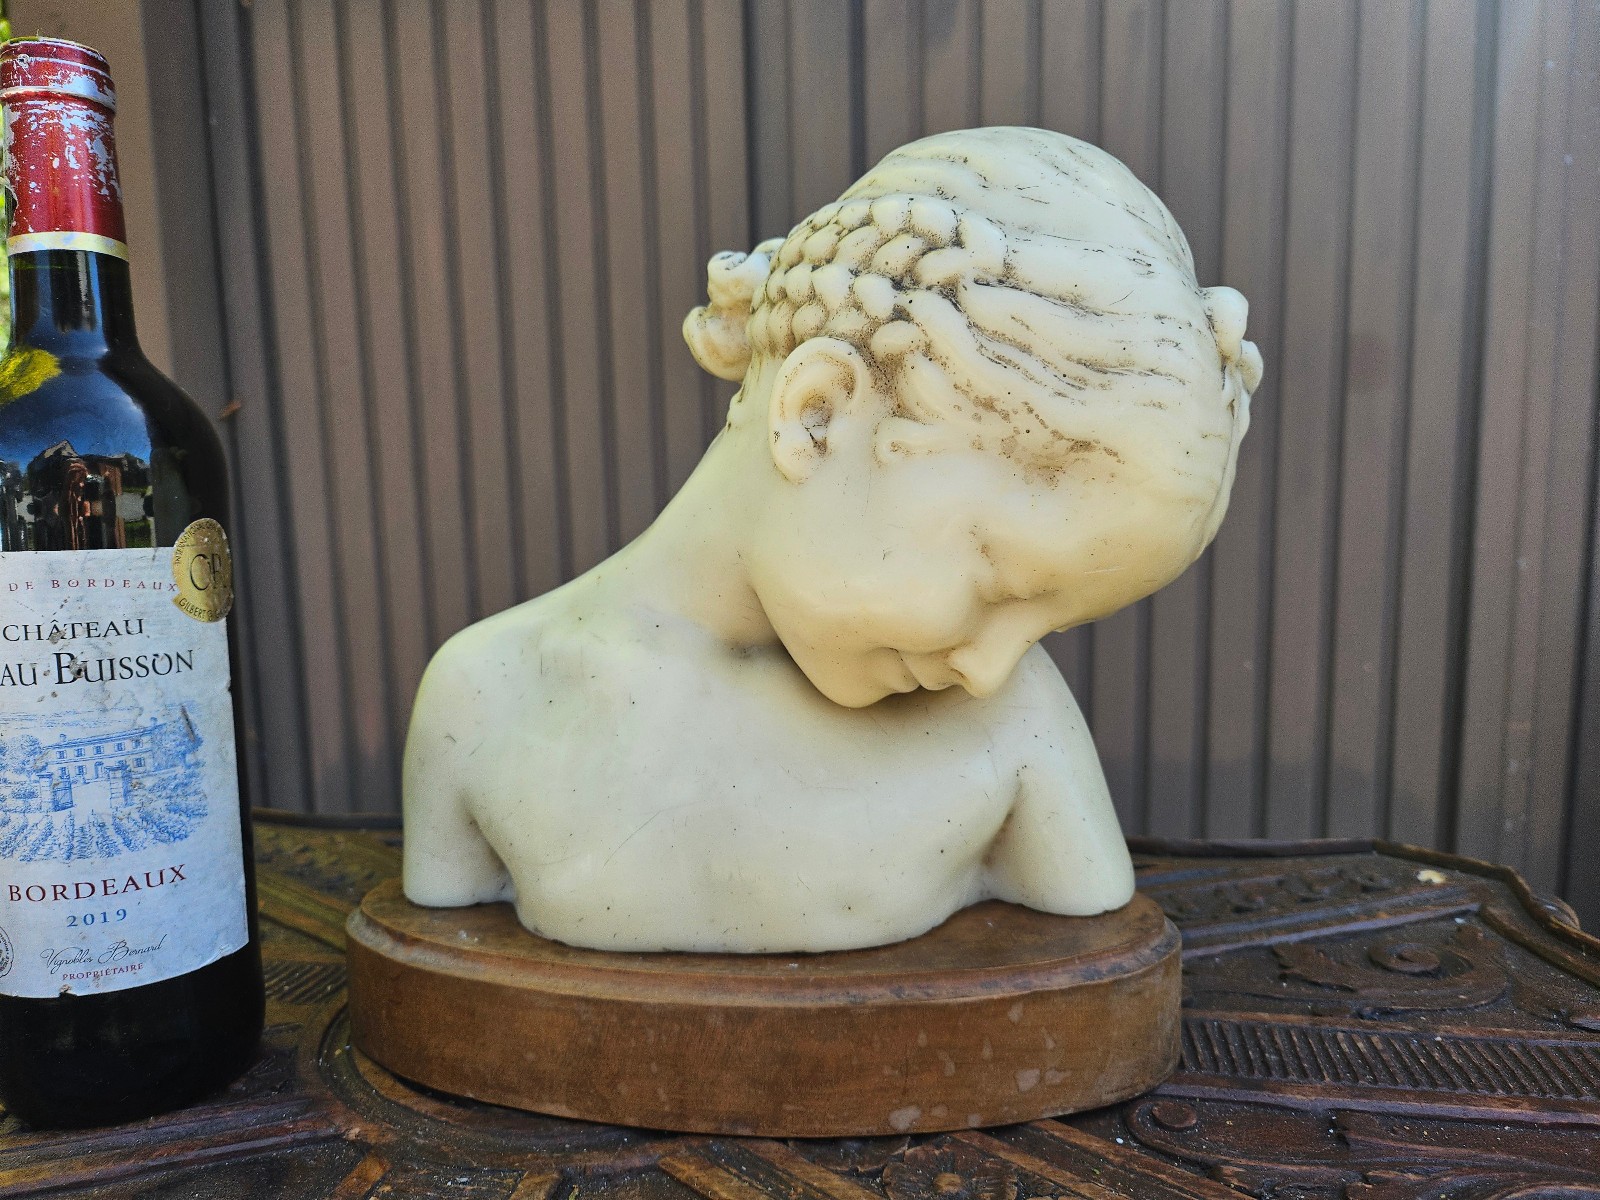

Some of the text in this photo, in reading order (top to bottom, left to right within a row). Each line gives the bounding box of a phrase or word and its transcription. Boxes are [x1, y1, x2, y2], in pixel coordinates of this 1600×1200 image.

[9, 578, 177, 592] DE BORDEAUX
[179, 597, 206, 619] GILBERT
[2, 618, 144, 642] CHÂTEAU
[8, 863, 187, 902] BORDEAUX
[66, 908, 127, 927] 2019
[40, 946, 93, 975] Vignobles
[98, 934, 167, 964] Bernard
[62, 962, 144, 981] PROPRIÉTAIRE
